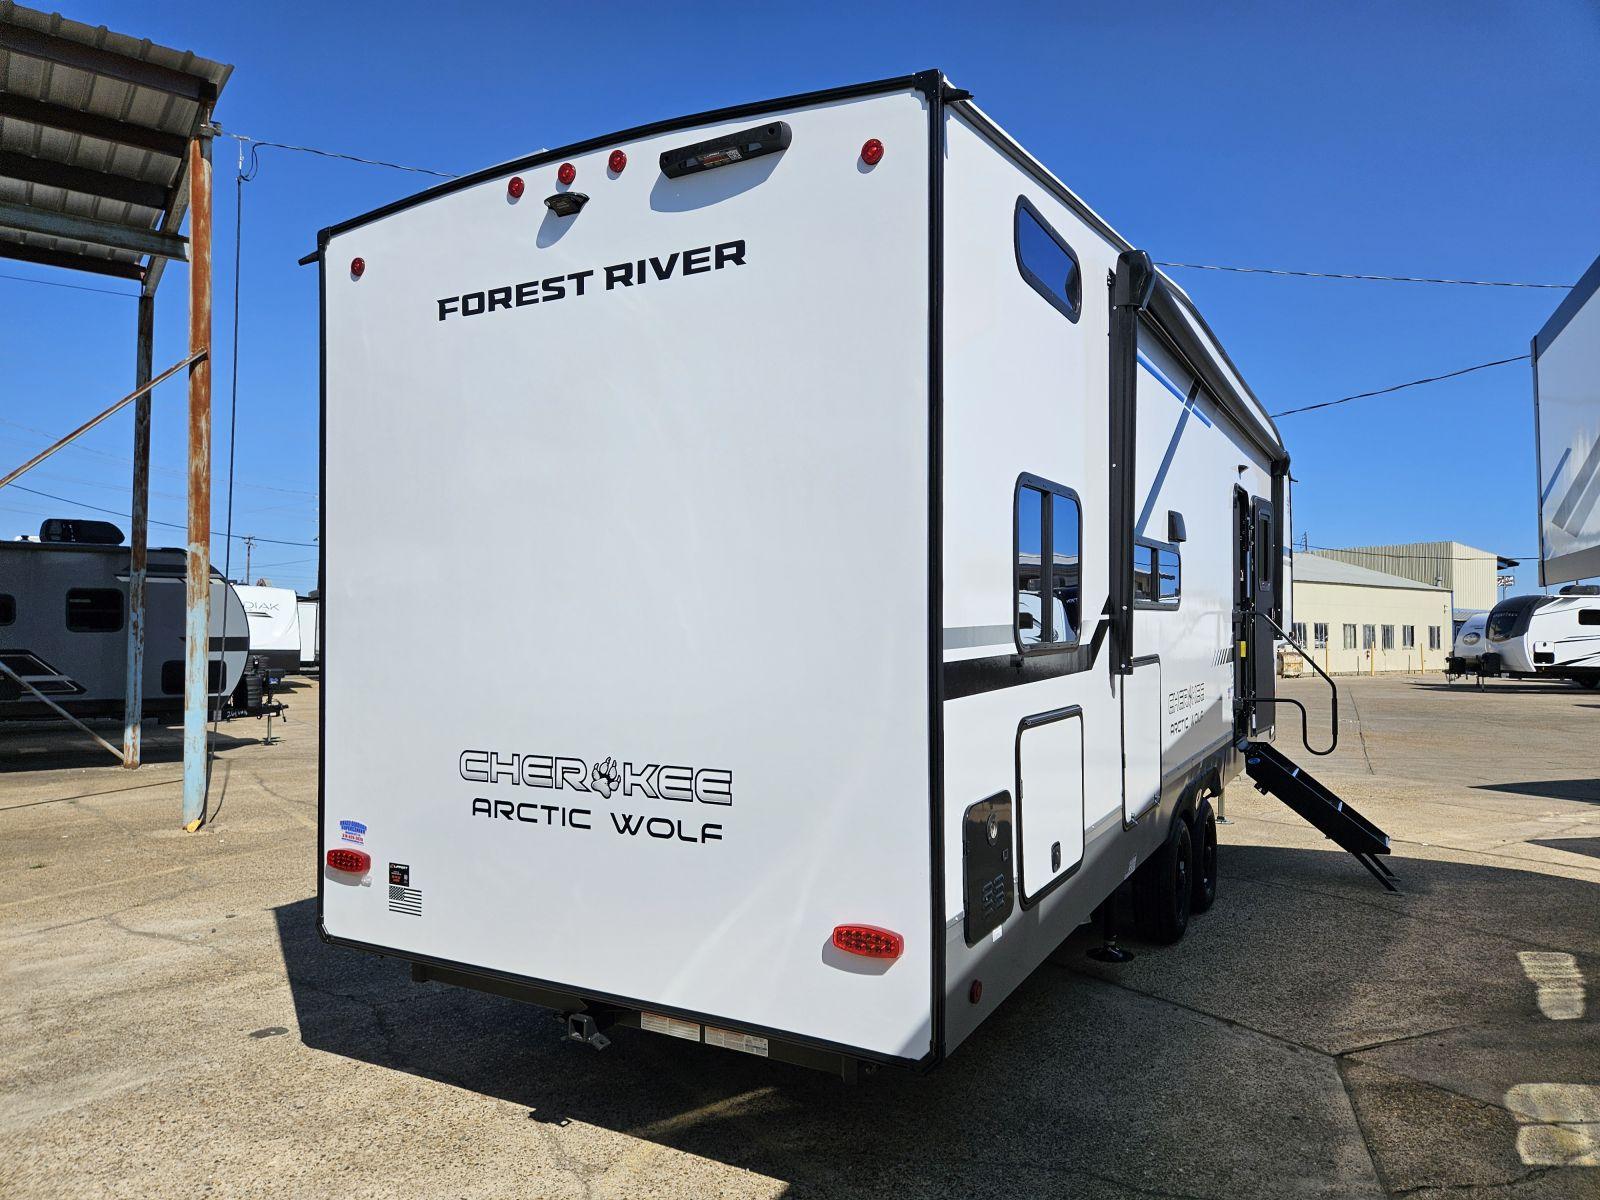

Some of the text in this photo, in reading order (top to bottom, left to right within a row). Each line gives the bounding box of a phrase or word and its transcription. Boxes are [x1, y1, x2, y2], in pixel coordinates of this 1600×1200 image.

[437, 240, 746, 321] FOREST RIVER
[243, 601, 279, 611] DIAK
[472, 797, 723, 844] ARCTIC WOLF
